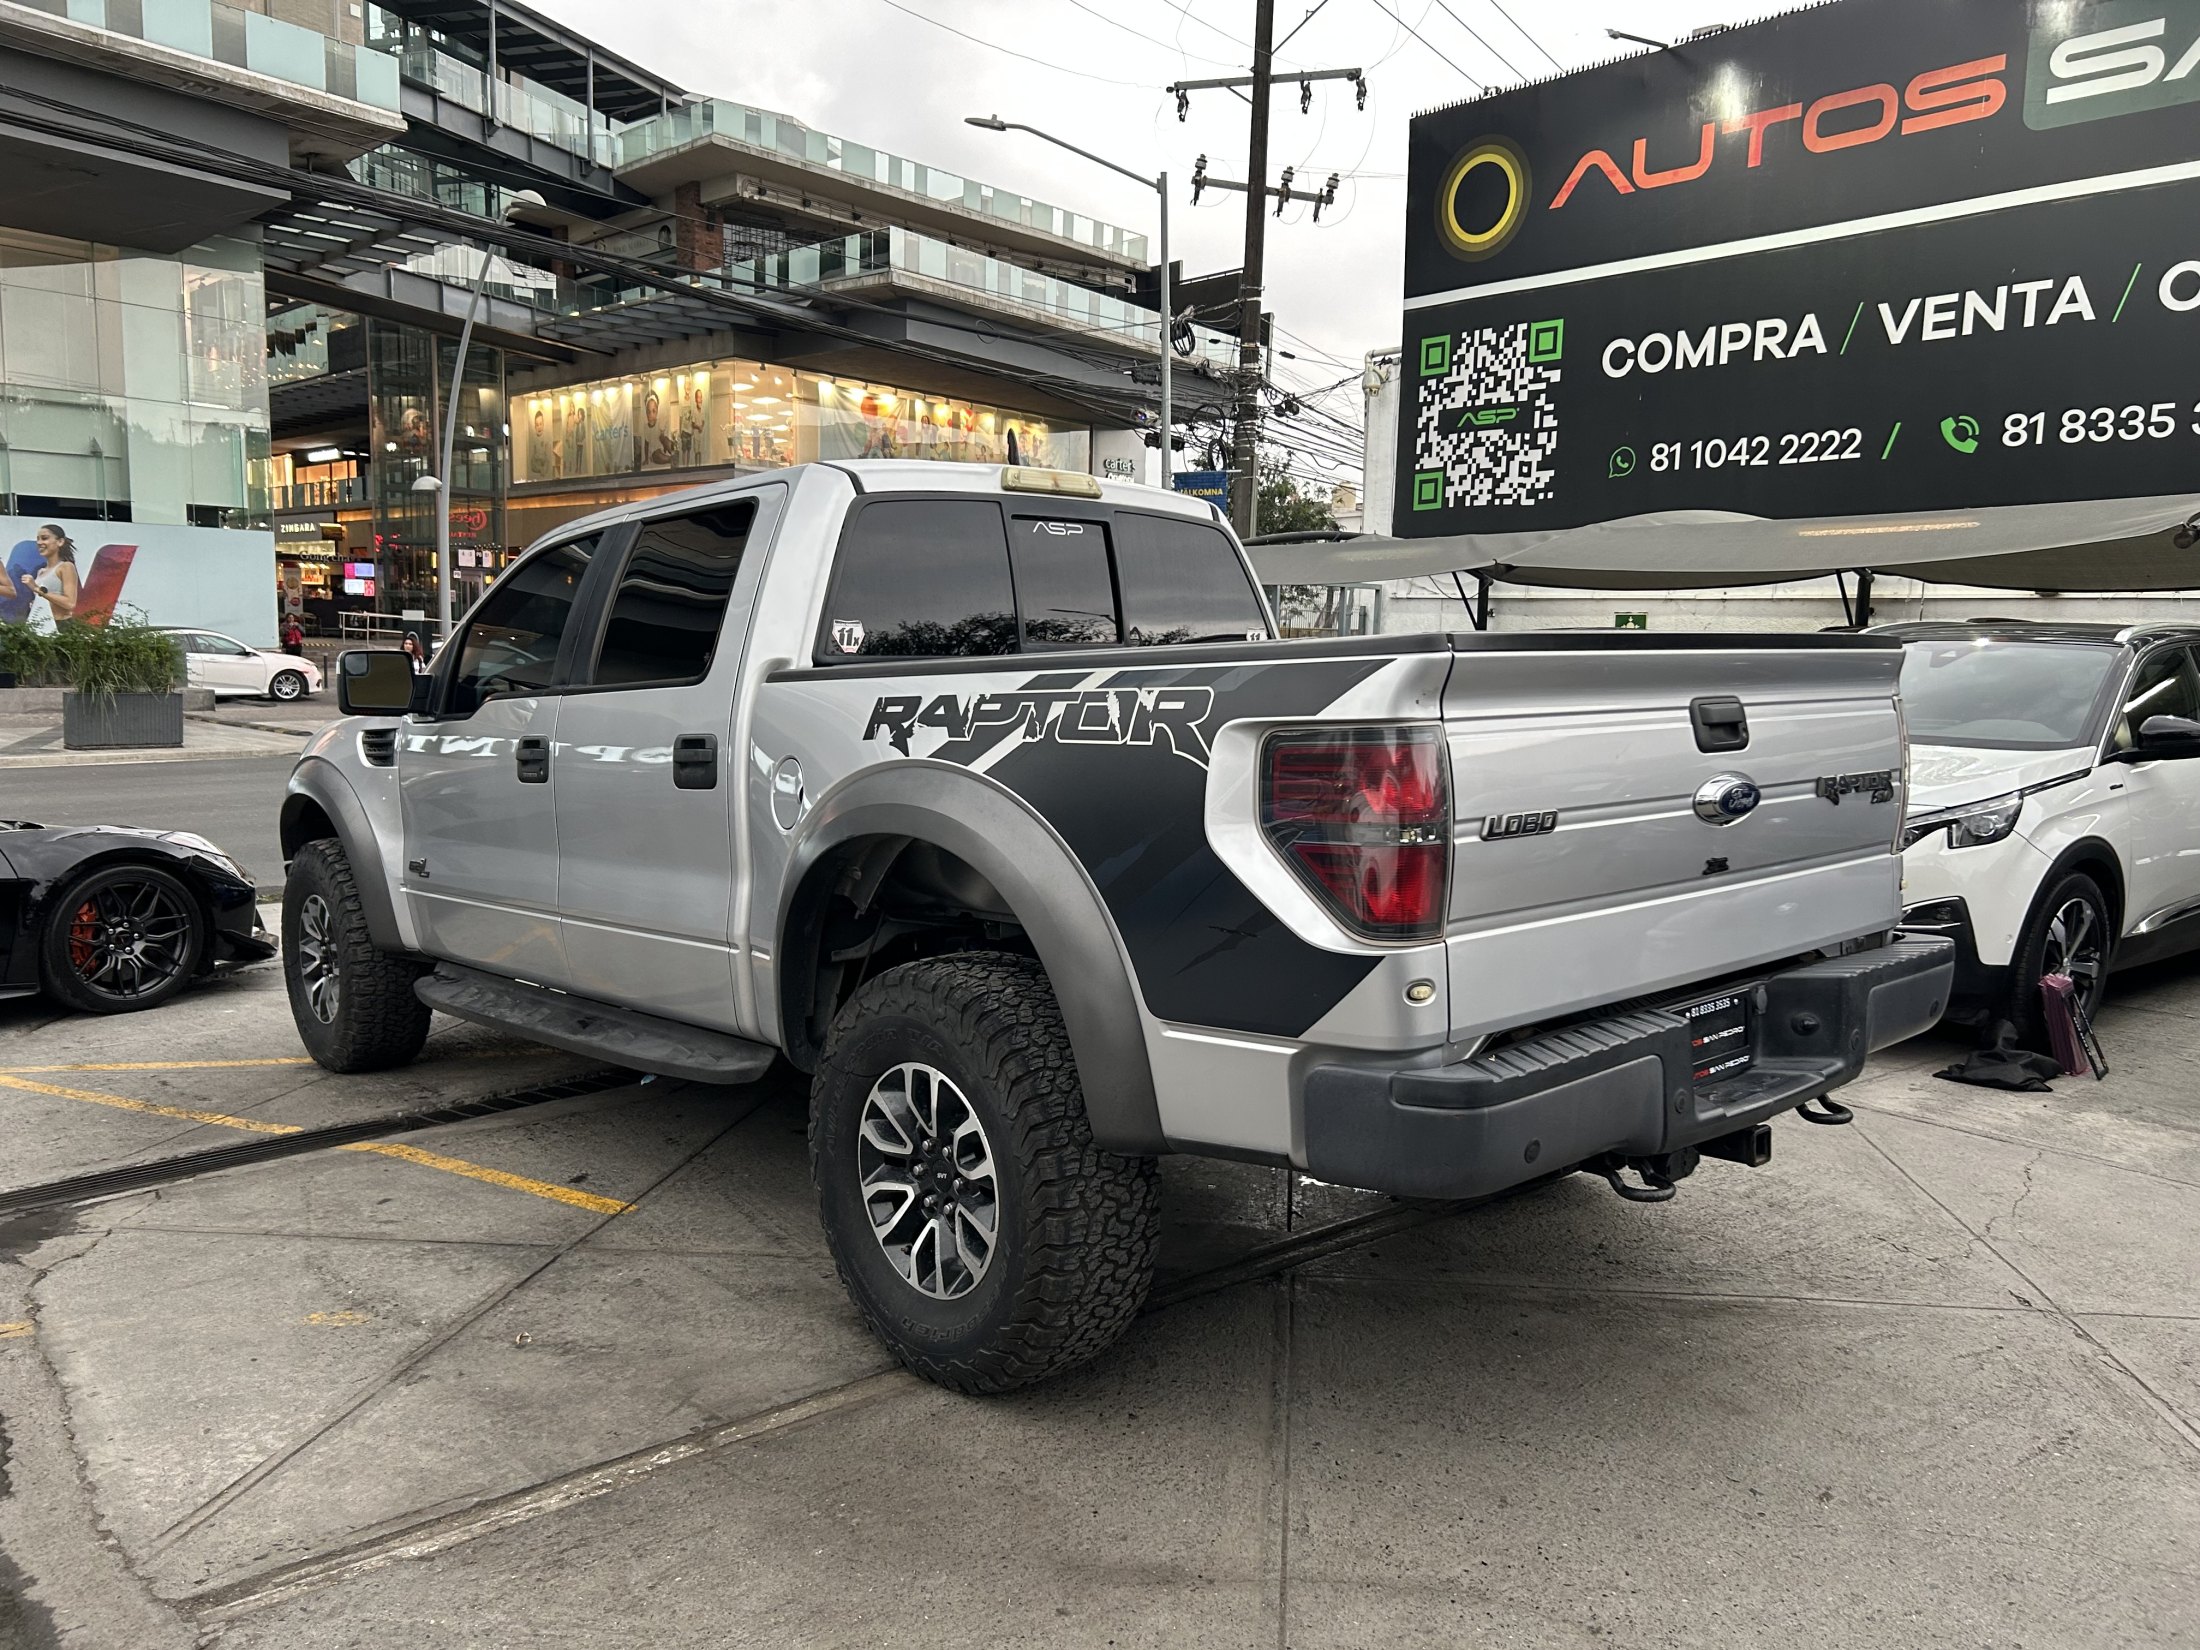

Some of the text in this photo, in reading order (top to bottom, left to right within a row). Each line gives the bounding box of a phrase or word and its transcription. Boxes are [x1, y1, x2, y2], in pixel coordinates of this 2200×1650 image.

[1549, 54, 2007, 210] AUTOS
[1601, 313, 1828, 379] COMPRA
[1877, 275, 2097, 345] VENTA
[1456, 407, 1518, 428] ASP
[1649, 441, 1682, 472] 81
[1690, 435, 1770, 470] 1042
[1778, 428, 1862, 465] 2222
[2001, 411, 2046, 447] 81
[2058, 402, 2176, 444] 8335
[1104, 458, 1136, 472] carter's
[280, 522, 316, 534] ZINGARA
[1032, 521, 1084, 536] ASP
[299, 550, 330, 564] Gong
[863, 686, 1212, 771] RAPTOR
[1479, 809, 1558, 842] LOBO
